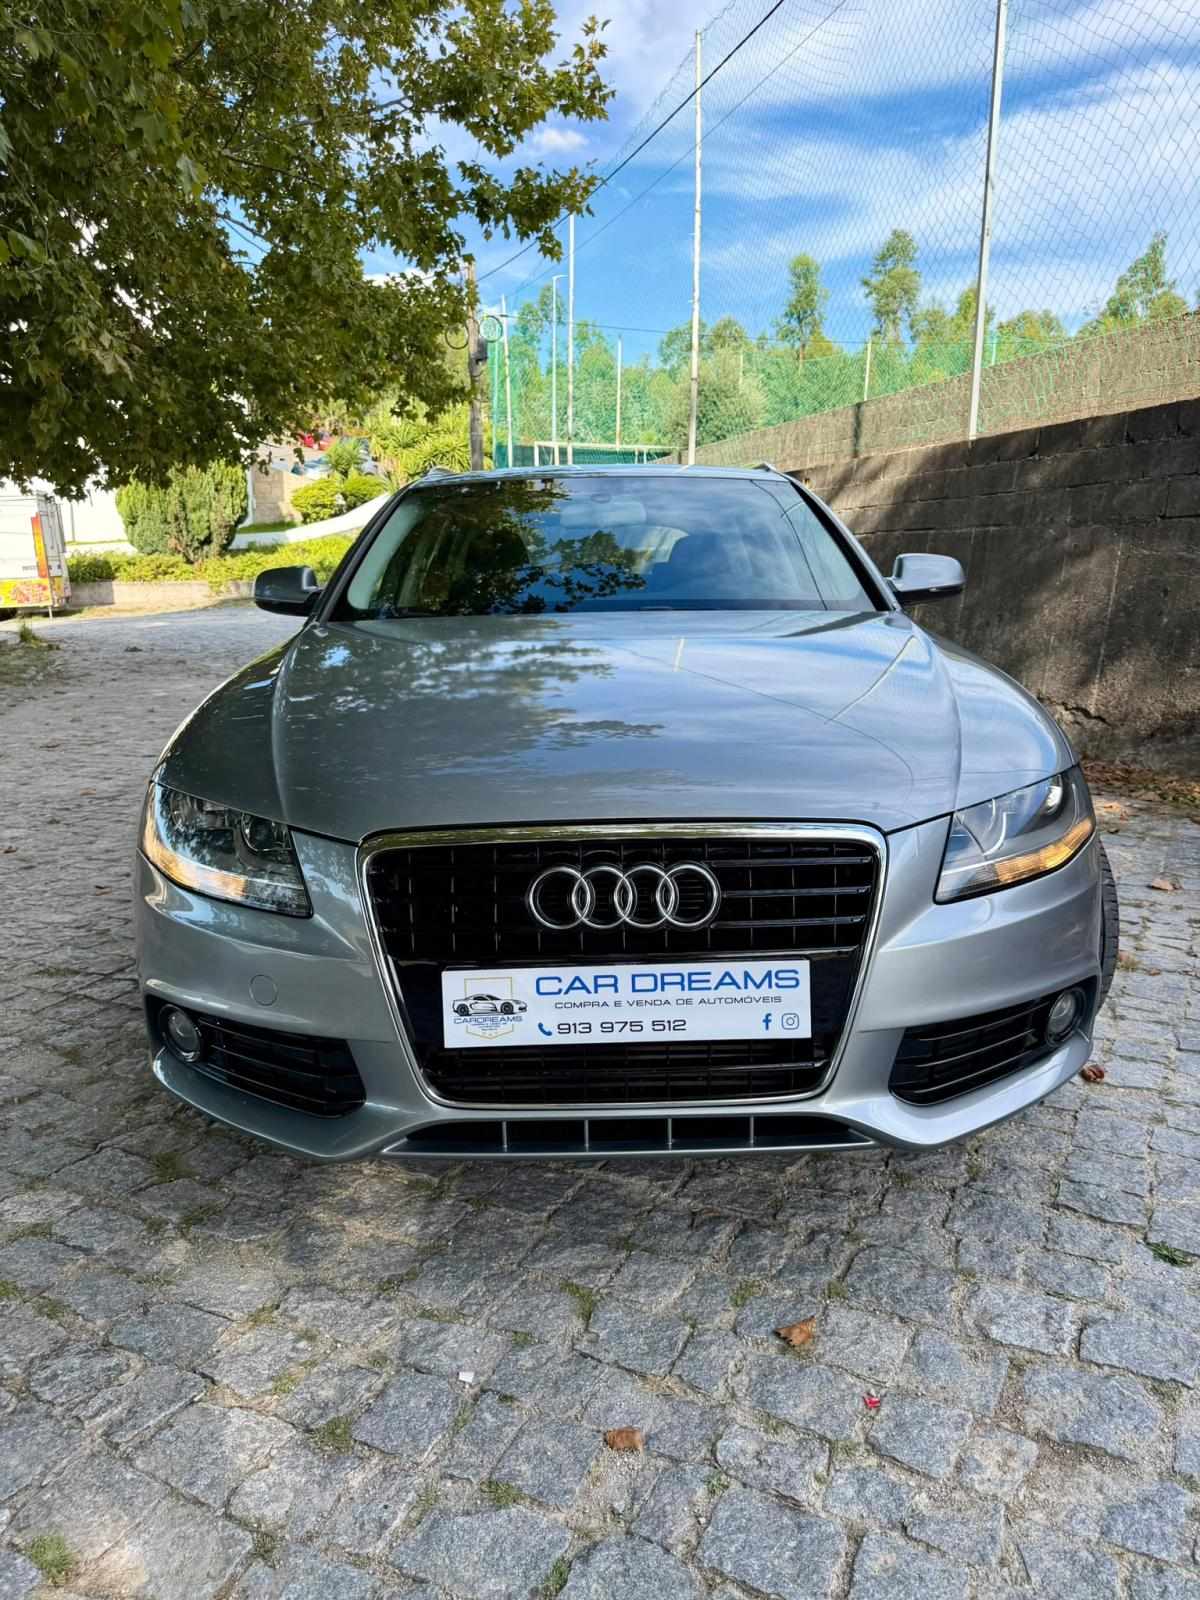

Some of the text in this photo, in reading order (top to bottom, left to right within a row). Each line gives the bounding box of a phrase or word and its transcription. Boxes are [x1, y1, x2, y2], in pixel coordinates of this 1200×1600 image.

[535, 969, 800, 996] CAR DREAMS
[554, 994, 782, 1009] COMPRA E VENDA DE AUTOMÓVEIS
[557, 1019, 687, 1035] 913 975 512
